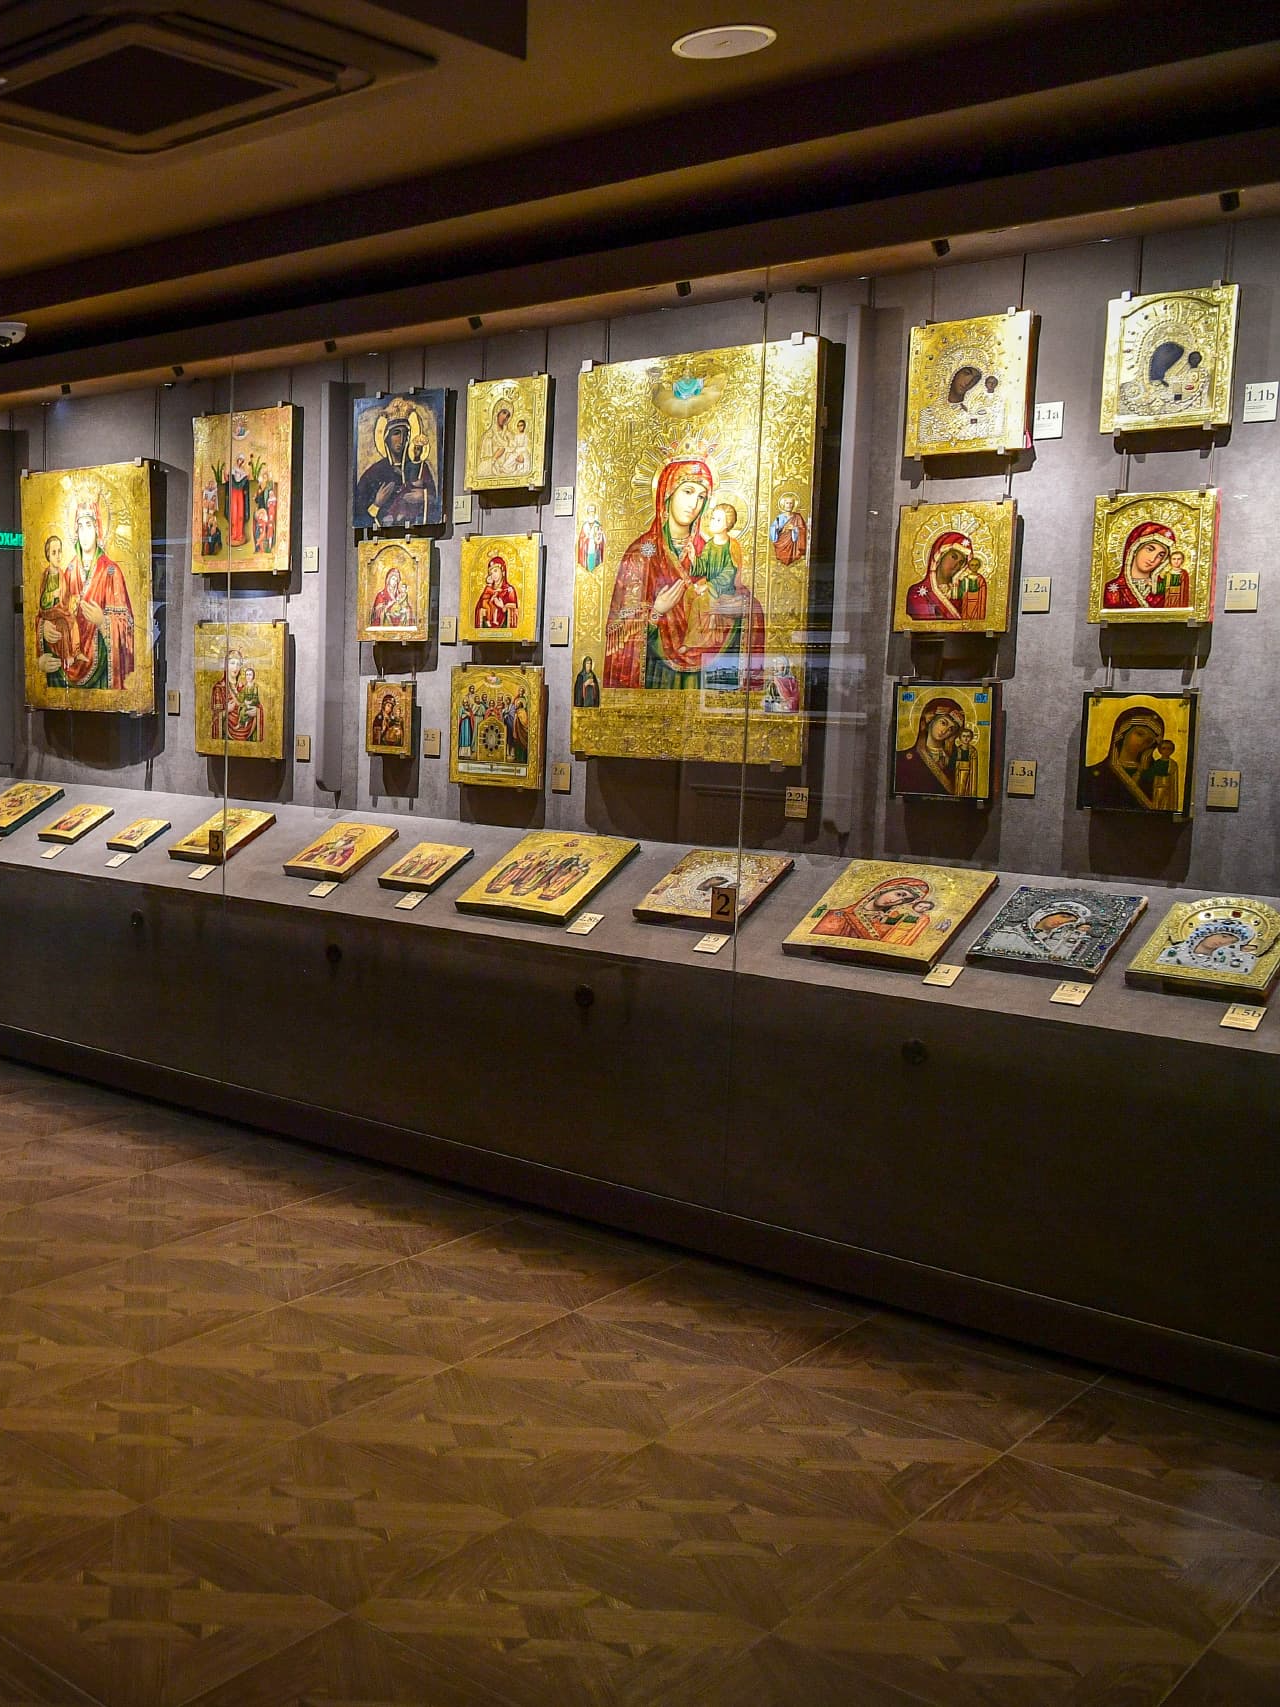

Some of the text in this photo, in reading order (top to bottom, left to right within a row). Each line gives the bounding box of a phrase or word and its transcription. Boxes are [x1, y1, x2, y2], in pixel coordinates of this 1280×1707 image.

[1246, 389, 1275, 401] 1.1b
[1036, 409, 1059, 420] 1.1a
[1024, 583, 1048, 593] 1.2a
[1228, 579, 1257, 591] 1.2b
[1009, 765, 1034, 777] 1.3a
[1209, 776, 1239, 788] 1.3b
[786, 792, 808, 803] 2.2b
[211, 835, 220, 852] 3
[716, 893, 730, 915] 2
[1230, 1007, 1262, 1018] 1.5b
